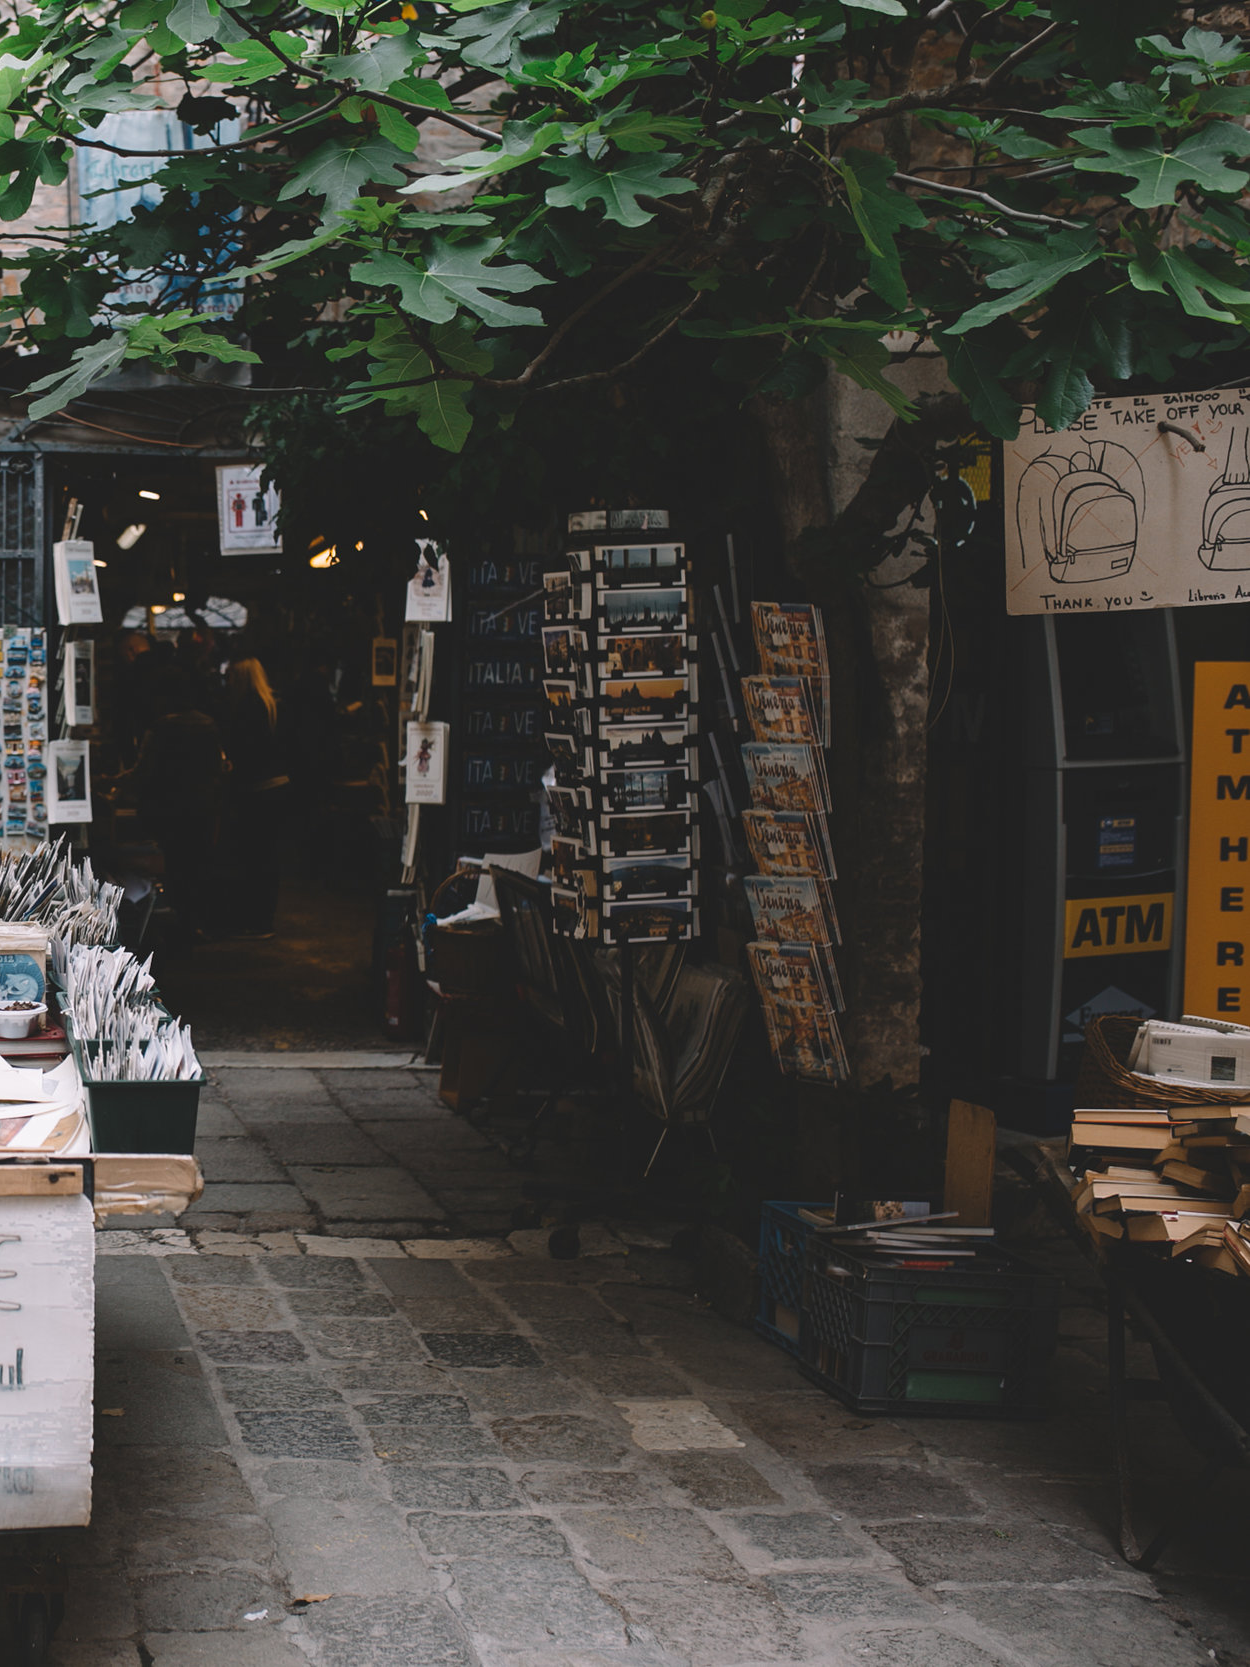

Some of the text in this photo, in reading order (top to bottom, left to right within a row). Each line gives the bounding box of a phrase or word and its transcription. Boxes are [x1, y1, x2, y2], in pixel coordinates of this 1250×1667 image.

[1134, 398, 1148, 406] EL
[1111, 408, 1156, 426] TAKE
[1166, 406, 1200, 421] OFF
[1209, 402, 1244, 419] YOUR
[1040, 594, 1133, 610] THANK YOU
[1188, 588, 1226, 602] Libreria
[469, 662, 523, 685] ITALIA
[1216, 684, 1250, 1013] ATM HERE
[1071, 902, 1166, 948] ATM
